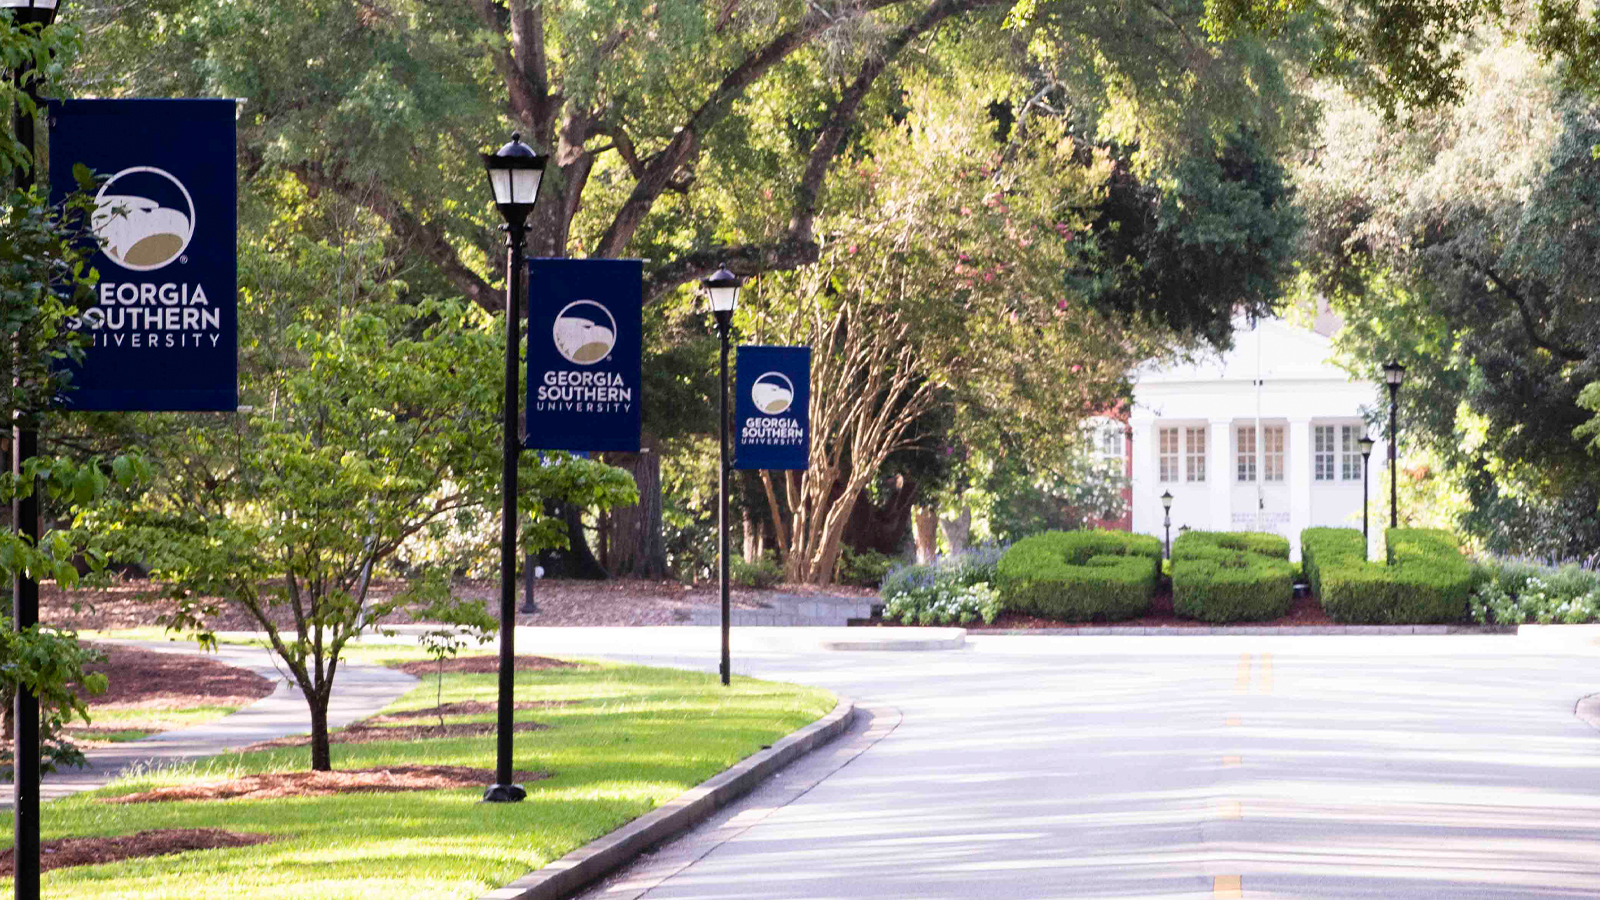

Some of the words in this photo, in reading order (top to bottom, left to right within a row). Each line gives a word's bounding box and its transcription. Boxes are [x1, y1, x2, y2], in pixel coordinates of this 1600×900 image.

[99, 282, 209, 306] EORGIA
[92, 332, 221, 348] IVERSITY
[543, 371, 624, 387] GEORGIA
[537, 385, 632, 402] SOUTHERN
[536, 401, 632, 413] UNIVERSITY
[745, 417, 799, 429] GEORGIA
[741, 426, 804, 439] SOUTHERN
[741, 437, 804, 446] UNIVERSITY
